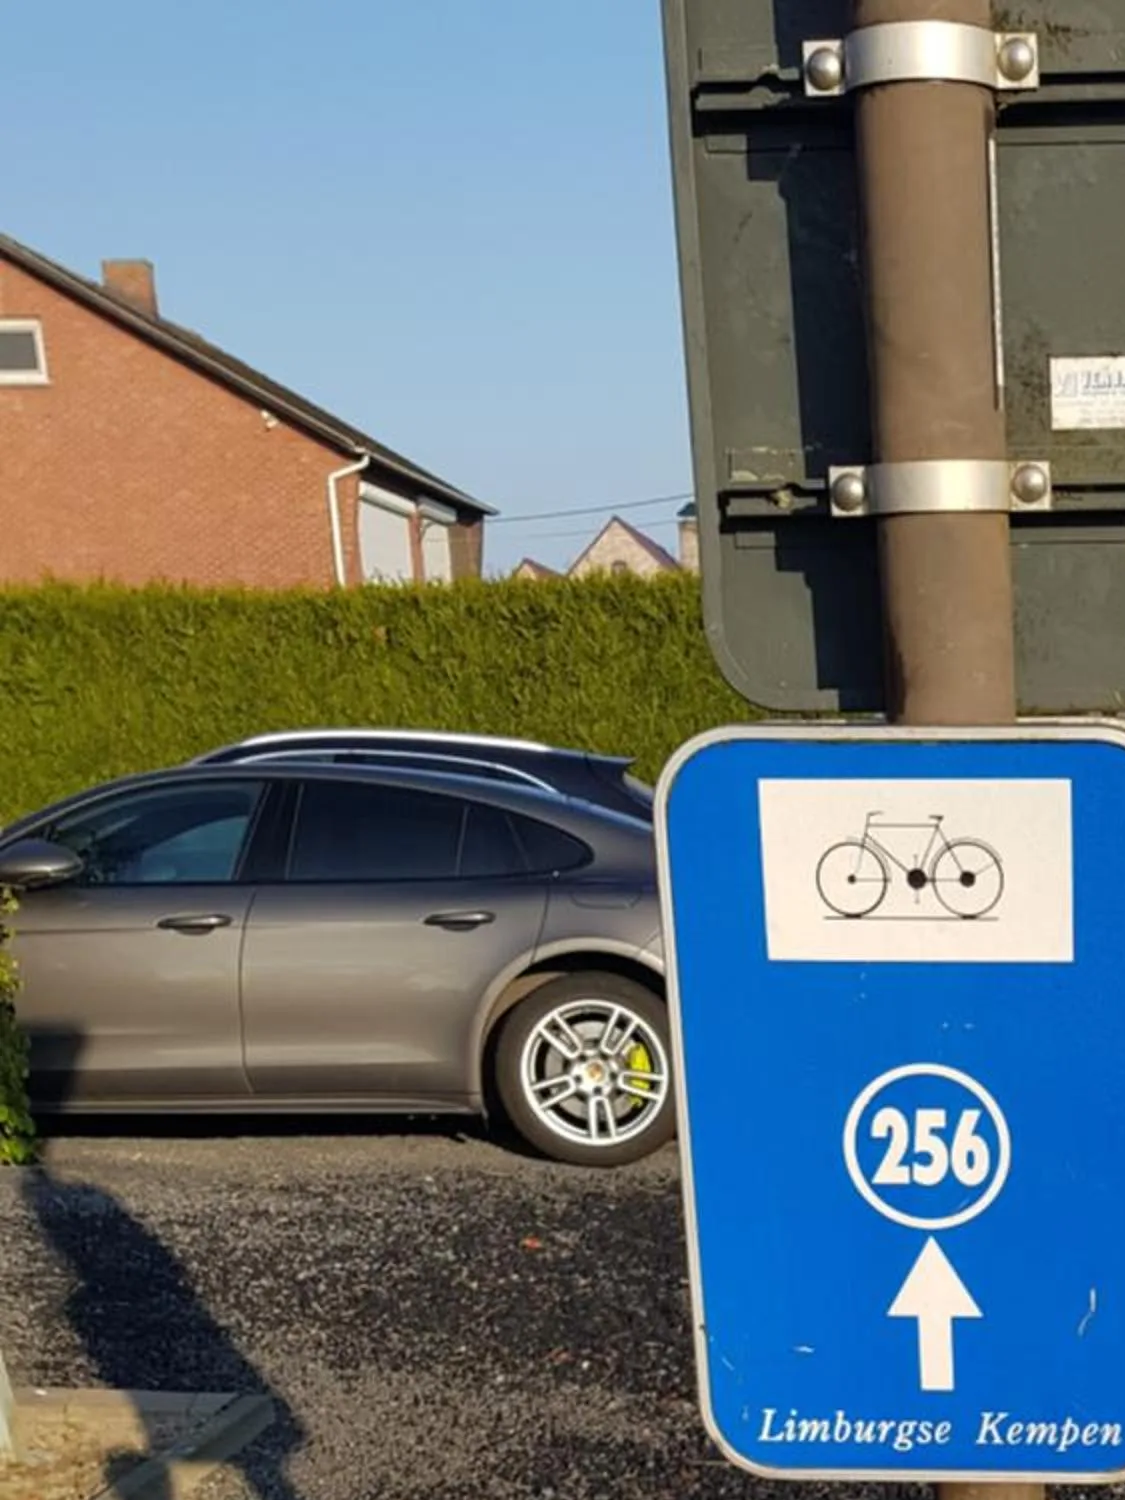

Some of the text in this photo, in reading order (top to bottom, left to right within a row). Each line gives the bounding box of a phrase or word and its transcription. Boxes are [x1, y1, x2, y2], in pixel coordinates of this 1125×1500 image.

[871, 1107, 990, 1186] 256
[758, 1408, 1123, 1452] Limburgse Kempen
